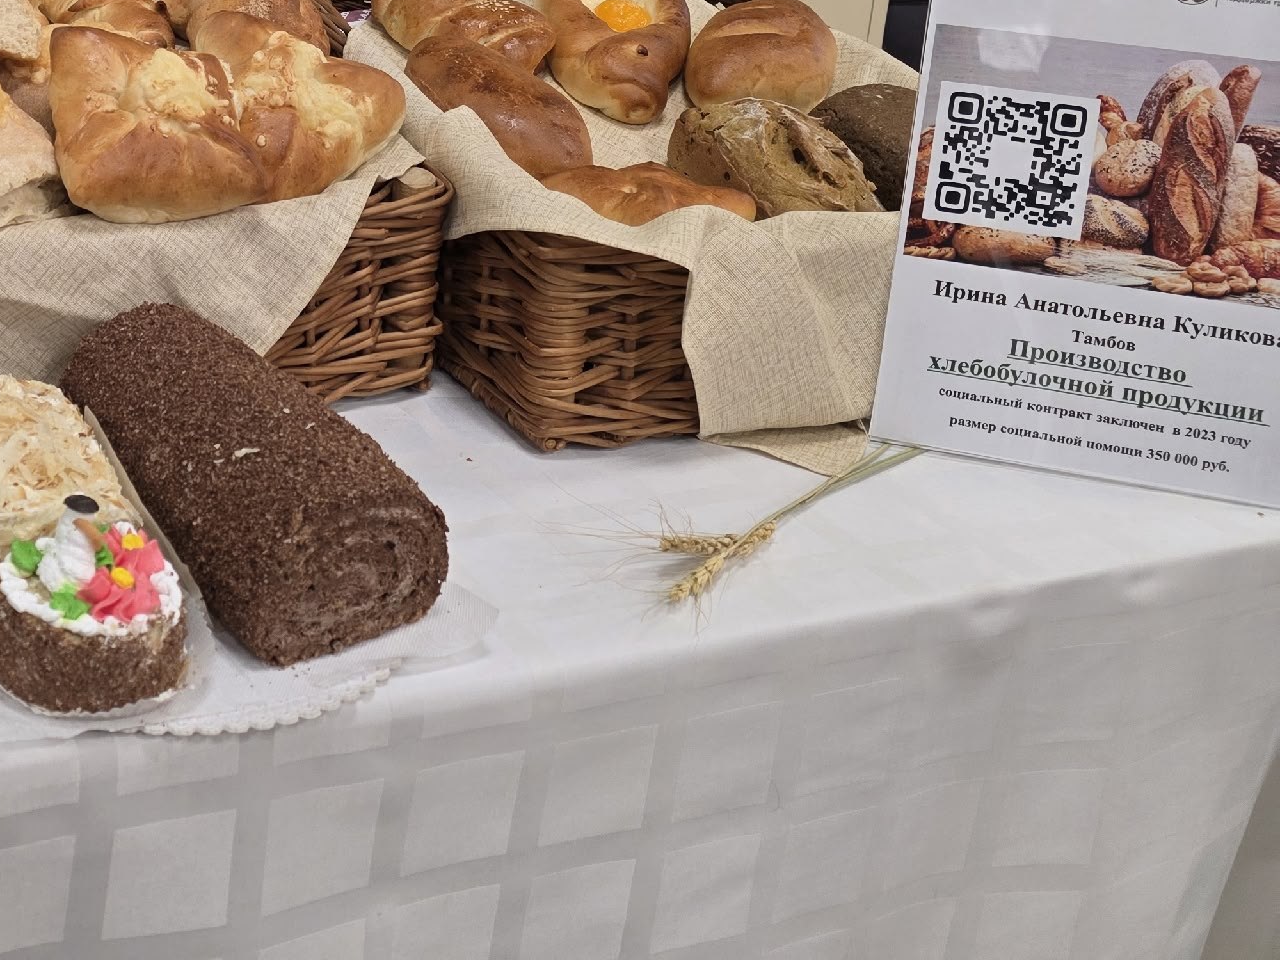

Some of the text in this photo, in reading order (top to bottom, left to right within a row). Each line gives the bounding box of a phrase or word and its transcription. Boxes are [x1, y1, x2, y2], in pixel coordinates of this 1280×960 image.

[932, 279, 1007, 306] Ирина
[1014, 292, 1165, 330] Анатольевна
[1008, 338, 1189, 384] Производство
[1071, 329, 1136, 351] Тамбов
[927, 354, 1265, 423] хлебобулочной продукции
[938, 387, 1252, 449] социальный контракт заключен в 2023 году
[949, 414, 1231, 473] размер социальной помощи 350 000 руб.
